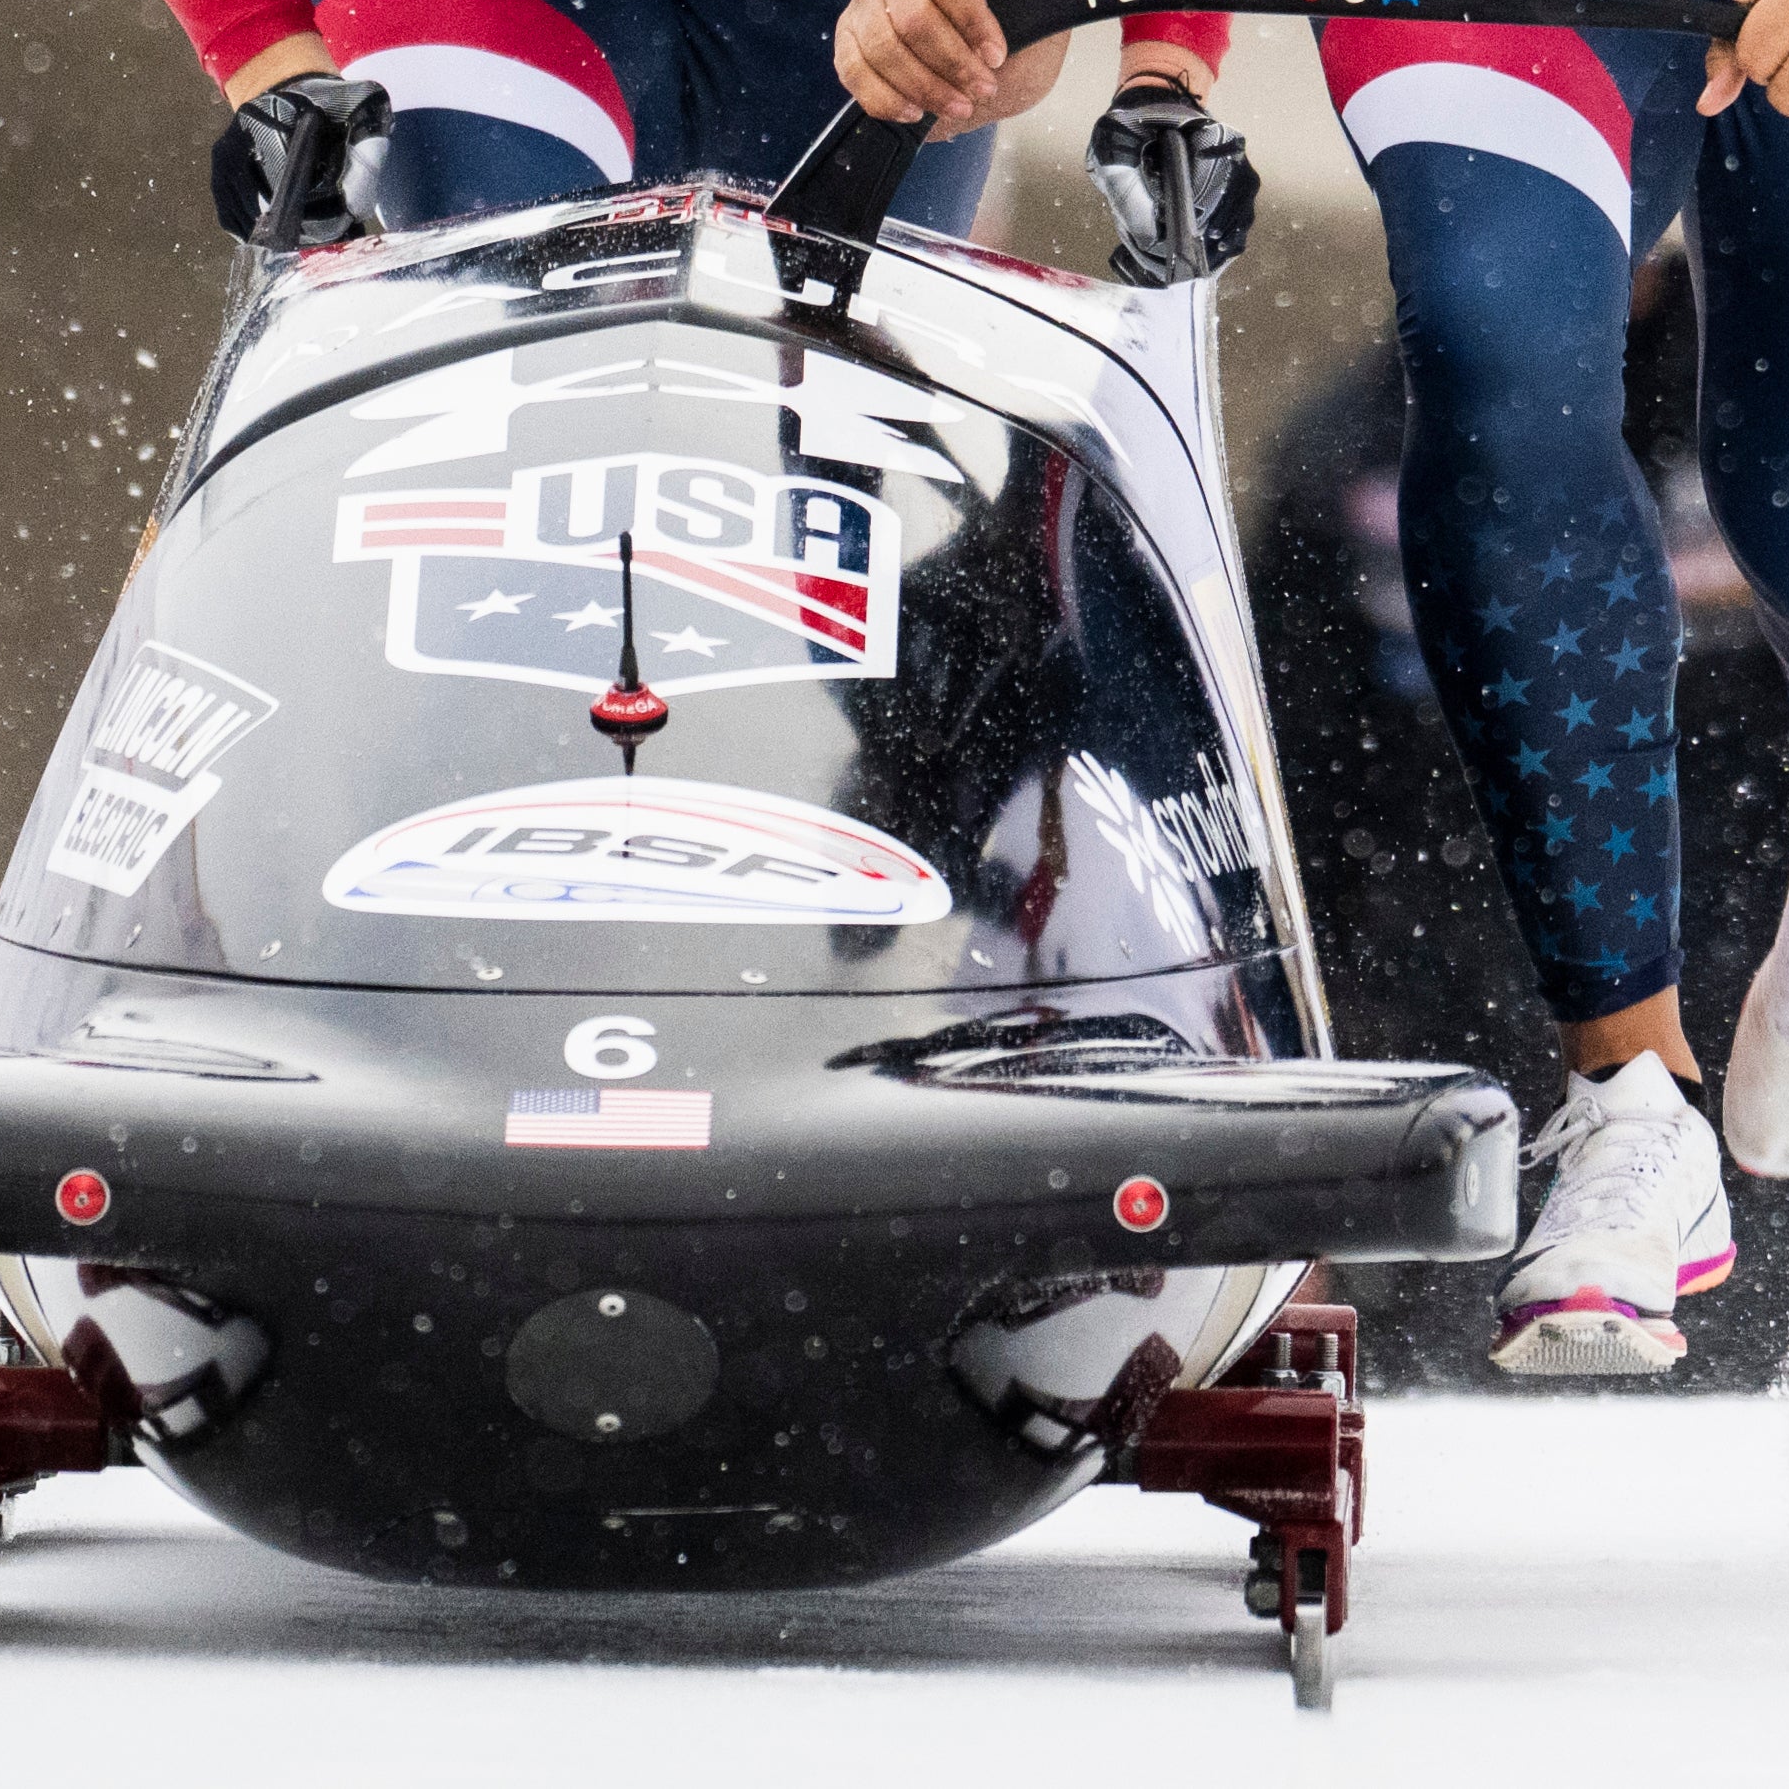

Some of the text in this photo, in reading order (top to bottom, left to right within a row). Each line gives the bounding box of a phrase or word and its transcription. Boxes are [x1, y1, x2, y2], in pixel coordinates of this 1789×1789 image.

[535, 464, 871, 575] USA
[93, 663, 251, 779] LINCOLN
[64, 787, 169, 870] ELECTRIC
[442, 826, 840, 884] IBSF
[564, 1015, 657, 1080] 6
